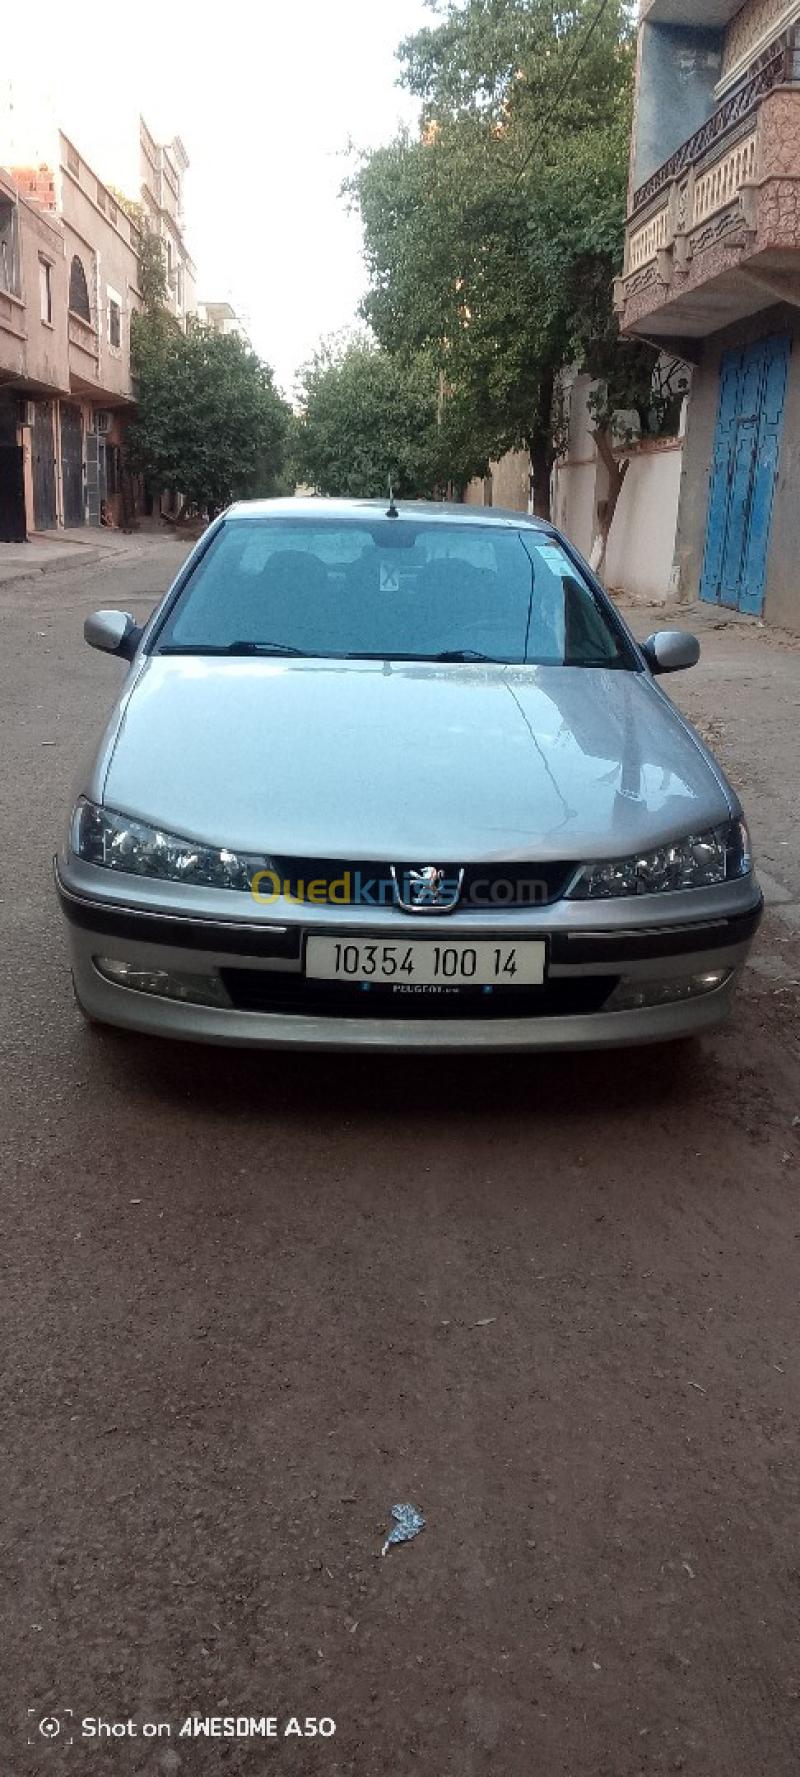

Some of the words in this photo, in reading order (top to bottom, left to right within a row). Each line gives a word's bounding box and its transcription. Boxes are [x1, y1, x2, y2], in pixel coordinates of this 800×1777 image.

[334, 944, 415, 976] 10354
[433, 947, 477, 977] 100
[494, 948, 518, 977] 14
